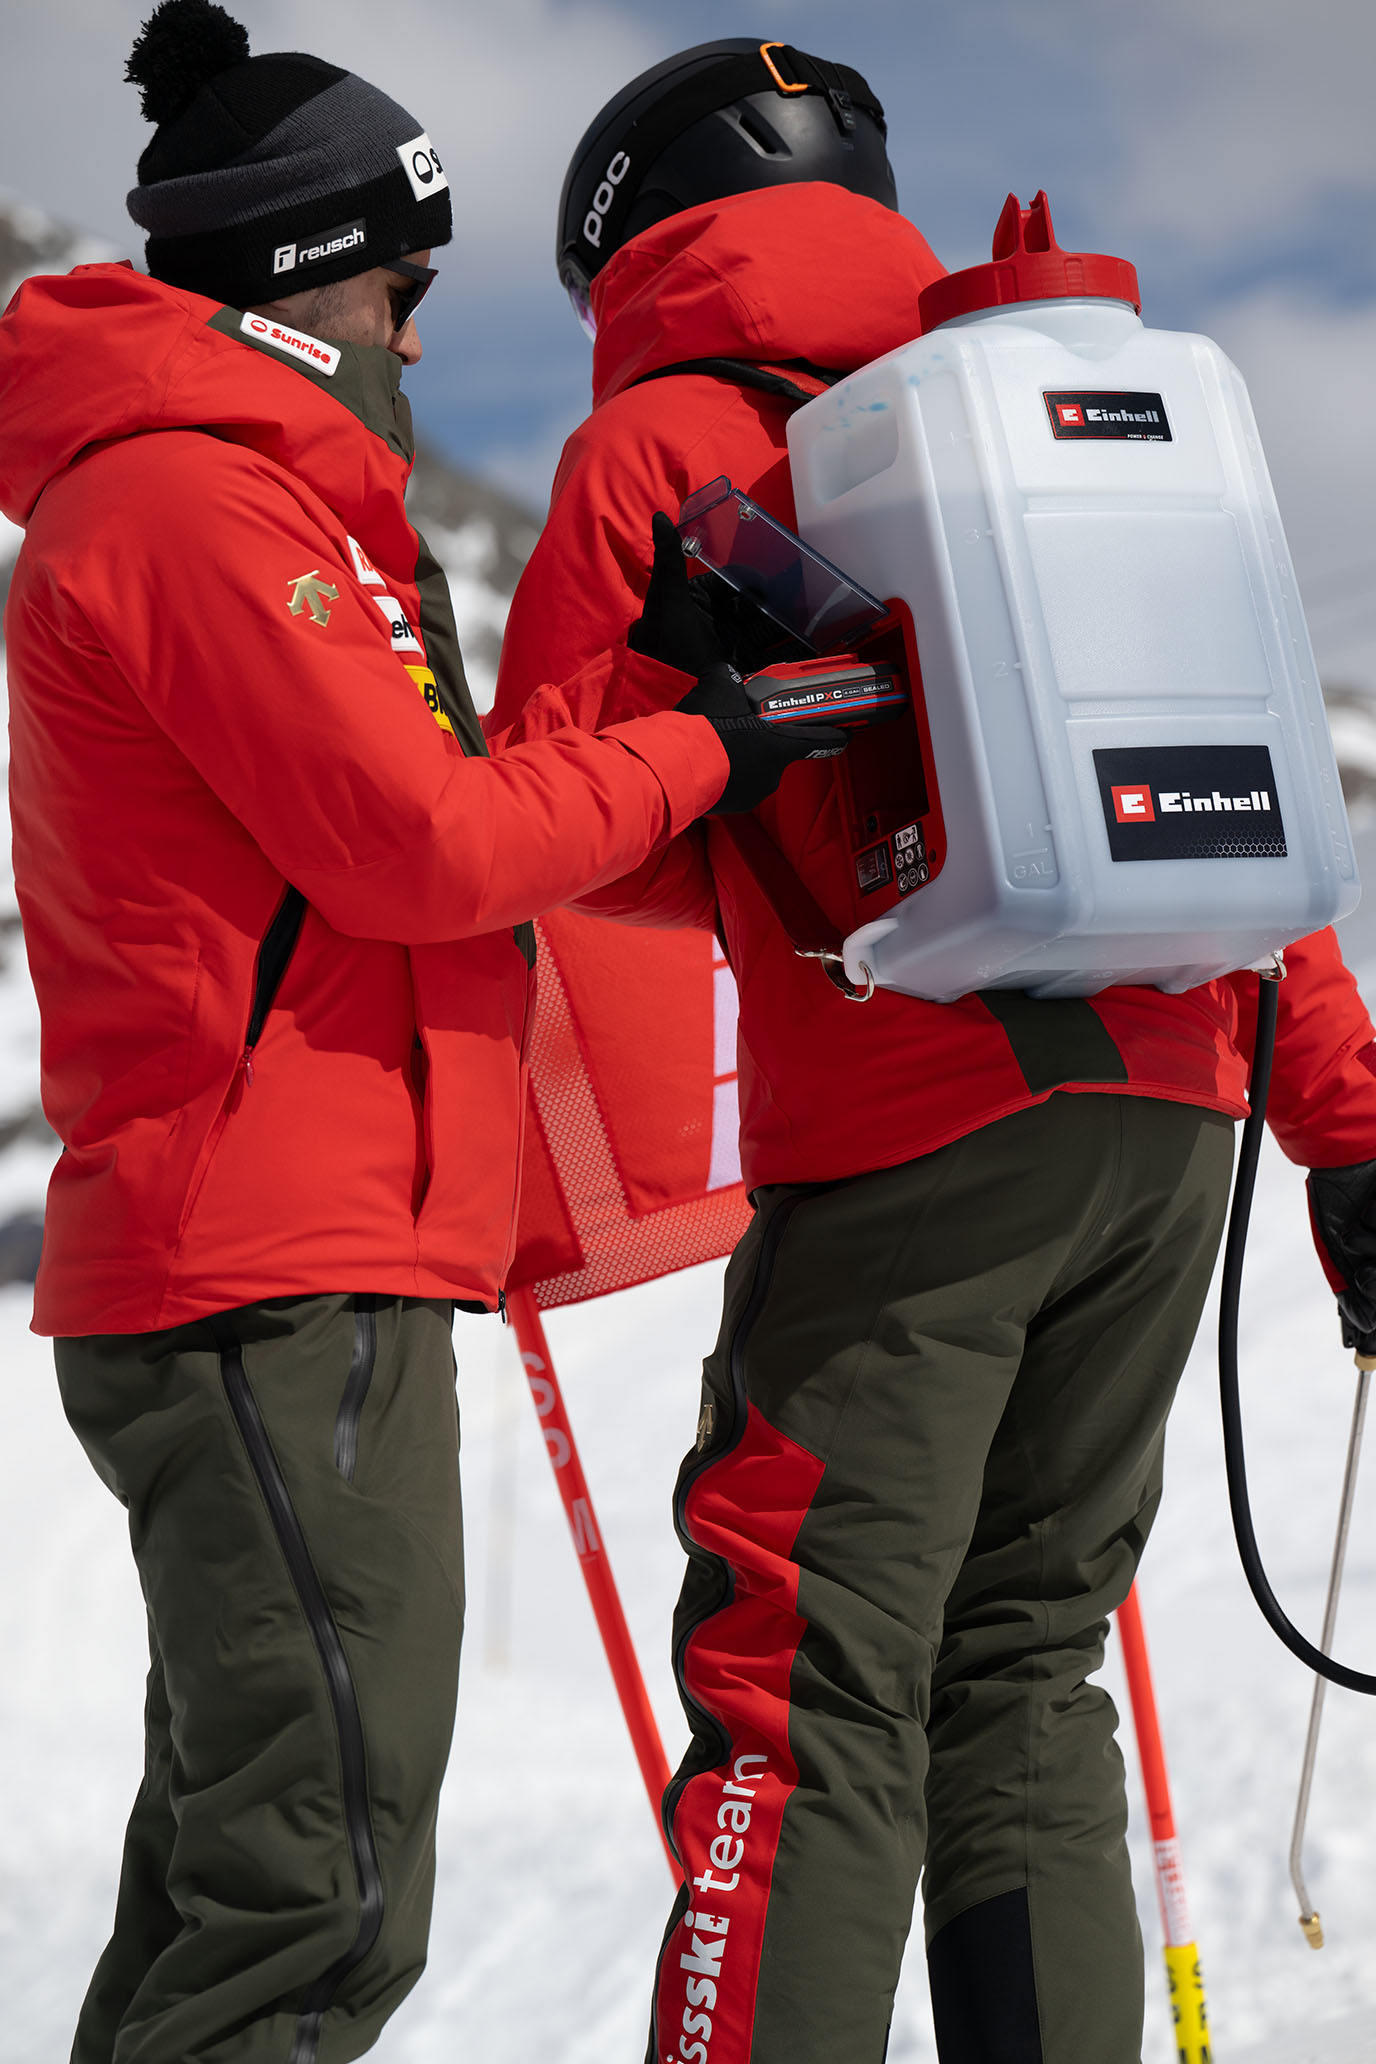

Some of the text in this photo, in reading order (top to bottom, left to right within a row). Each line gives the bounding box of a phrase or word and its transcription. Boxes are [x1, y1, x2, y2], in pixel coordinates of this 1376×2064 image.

[583, 150, 631, 248] POC
[299, 228, 365, 264] reusch
[270, 328, 332, 365] Sunrise
[1085, 408, 1160, 424] Einhell
[768, 694, 815, 710] Einhell
[816, 690, 843, 702] PXC
[1158, 791, 1272, 813] Einhell
[1014, 861, 1054, 880] GAL
[693, 1753, 769, 1893] team
